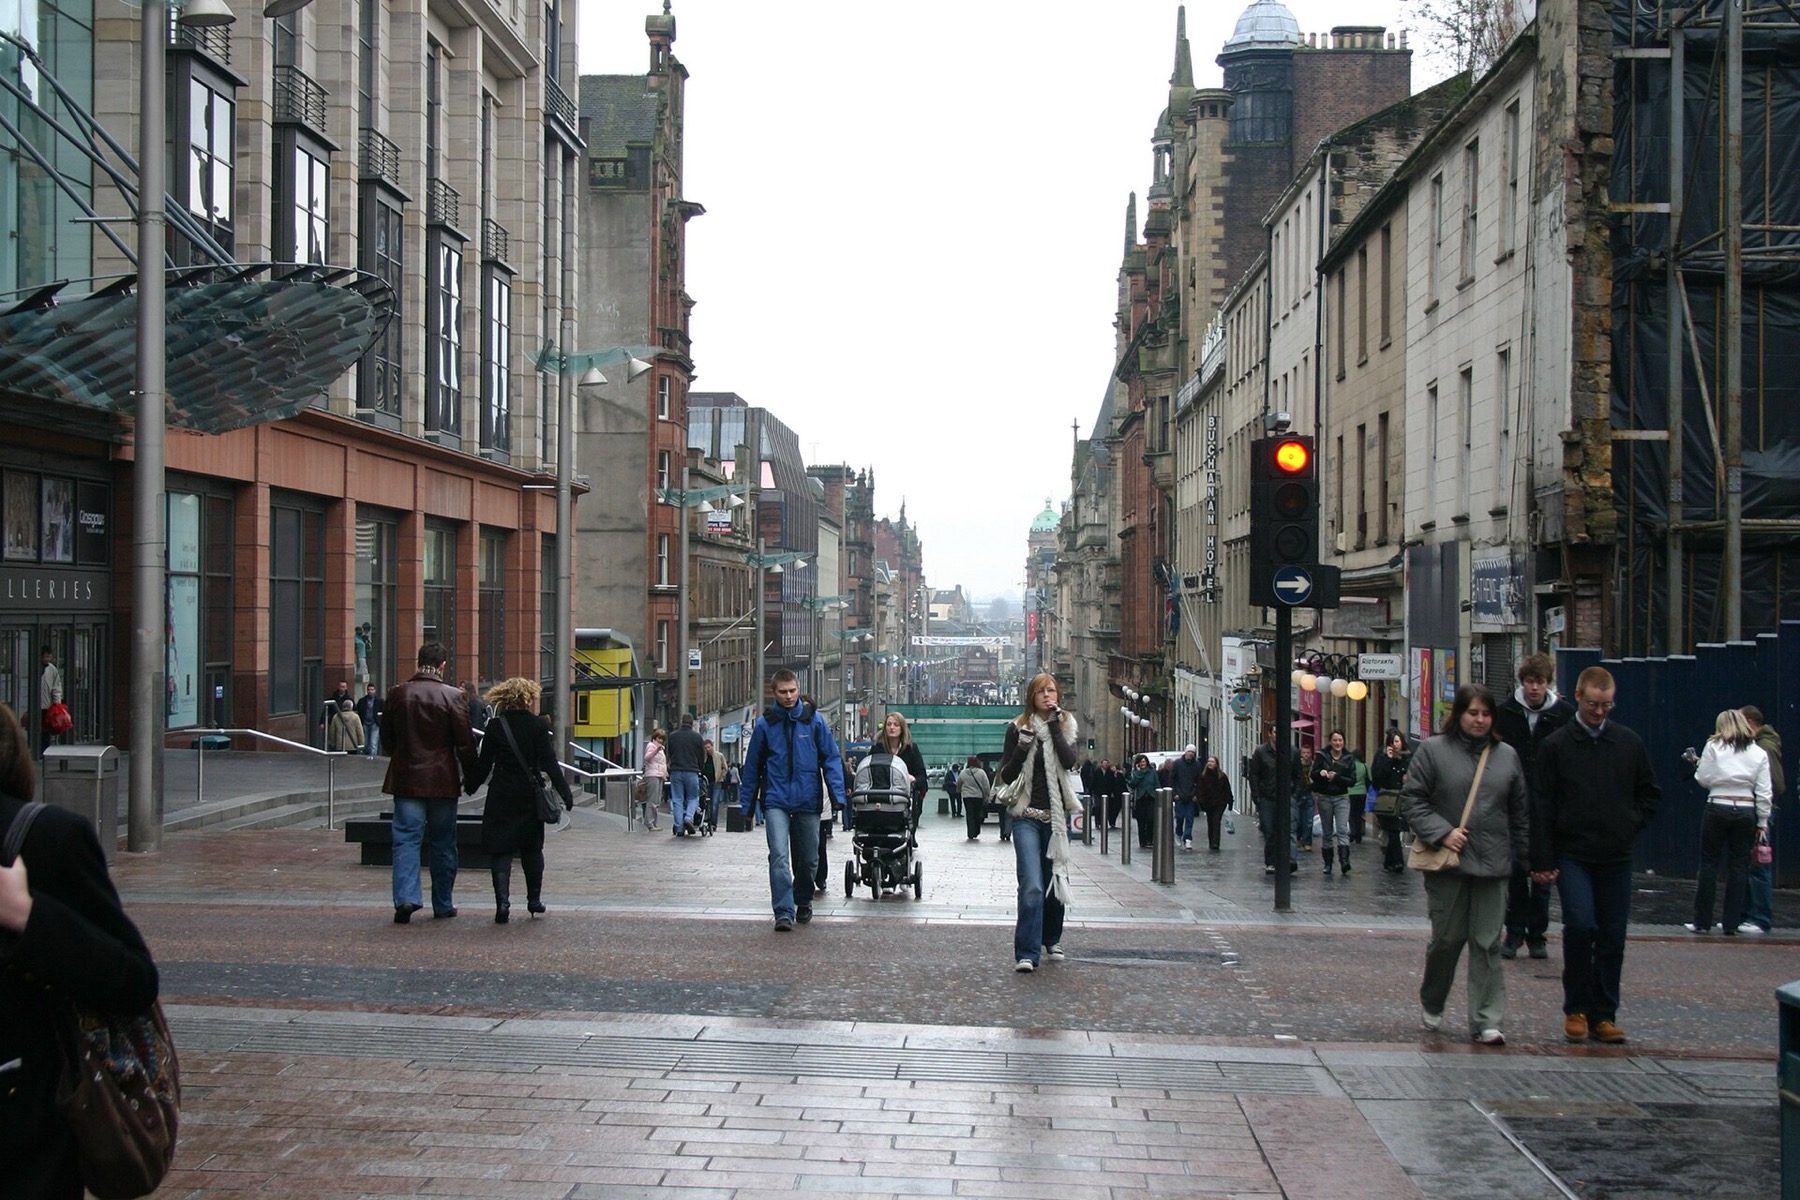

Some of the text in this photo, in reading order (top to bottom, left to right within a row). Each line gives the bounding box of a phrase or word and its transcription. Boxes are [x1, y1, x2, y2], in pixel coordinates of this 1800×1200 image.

[1206, 416, 1216, 603] BUCHANAN HOTEL
[8, 578, 92, 600] LLERIES
